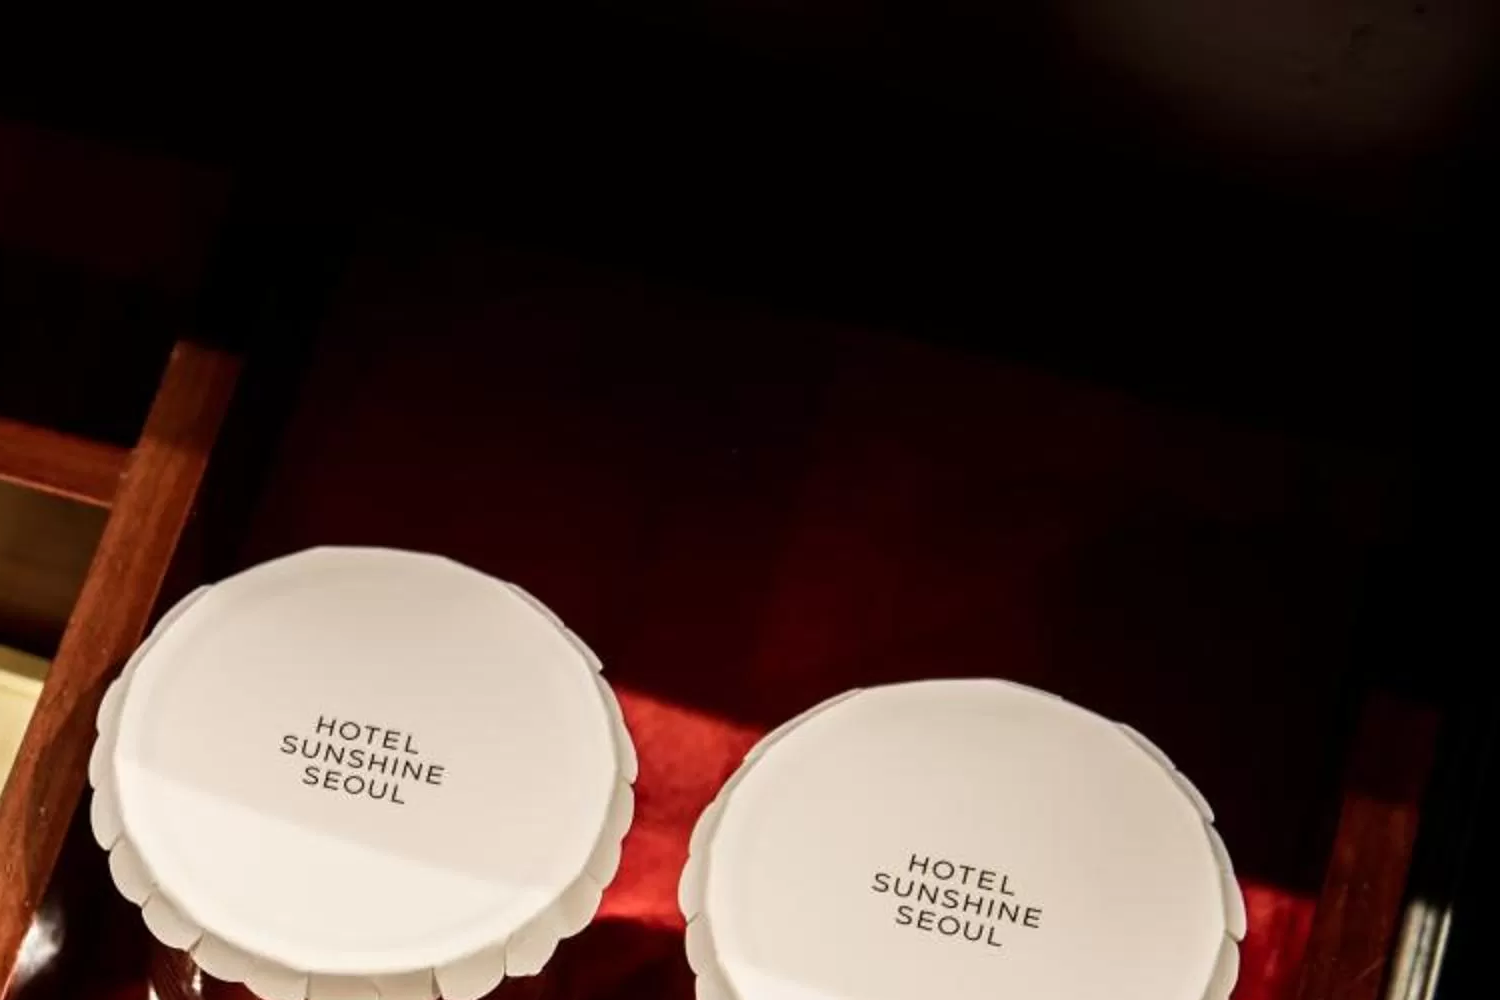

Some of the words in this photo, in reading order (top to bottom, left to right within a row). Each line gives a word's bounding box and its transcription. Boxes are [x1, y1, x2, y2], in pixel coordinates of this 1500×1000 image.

[315, 715, 419, 755] HOTEL
[280, 735, 446, 786] SUNSHINE
[302, 766, 405, 805] SEOUL
[908, 853, 1015, 897] HOTEL
[871, 872, 1043, 929] SUNSHINE
[895, 905, 1003, 947] SEOUL
